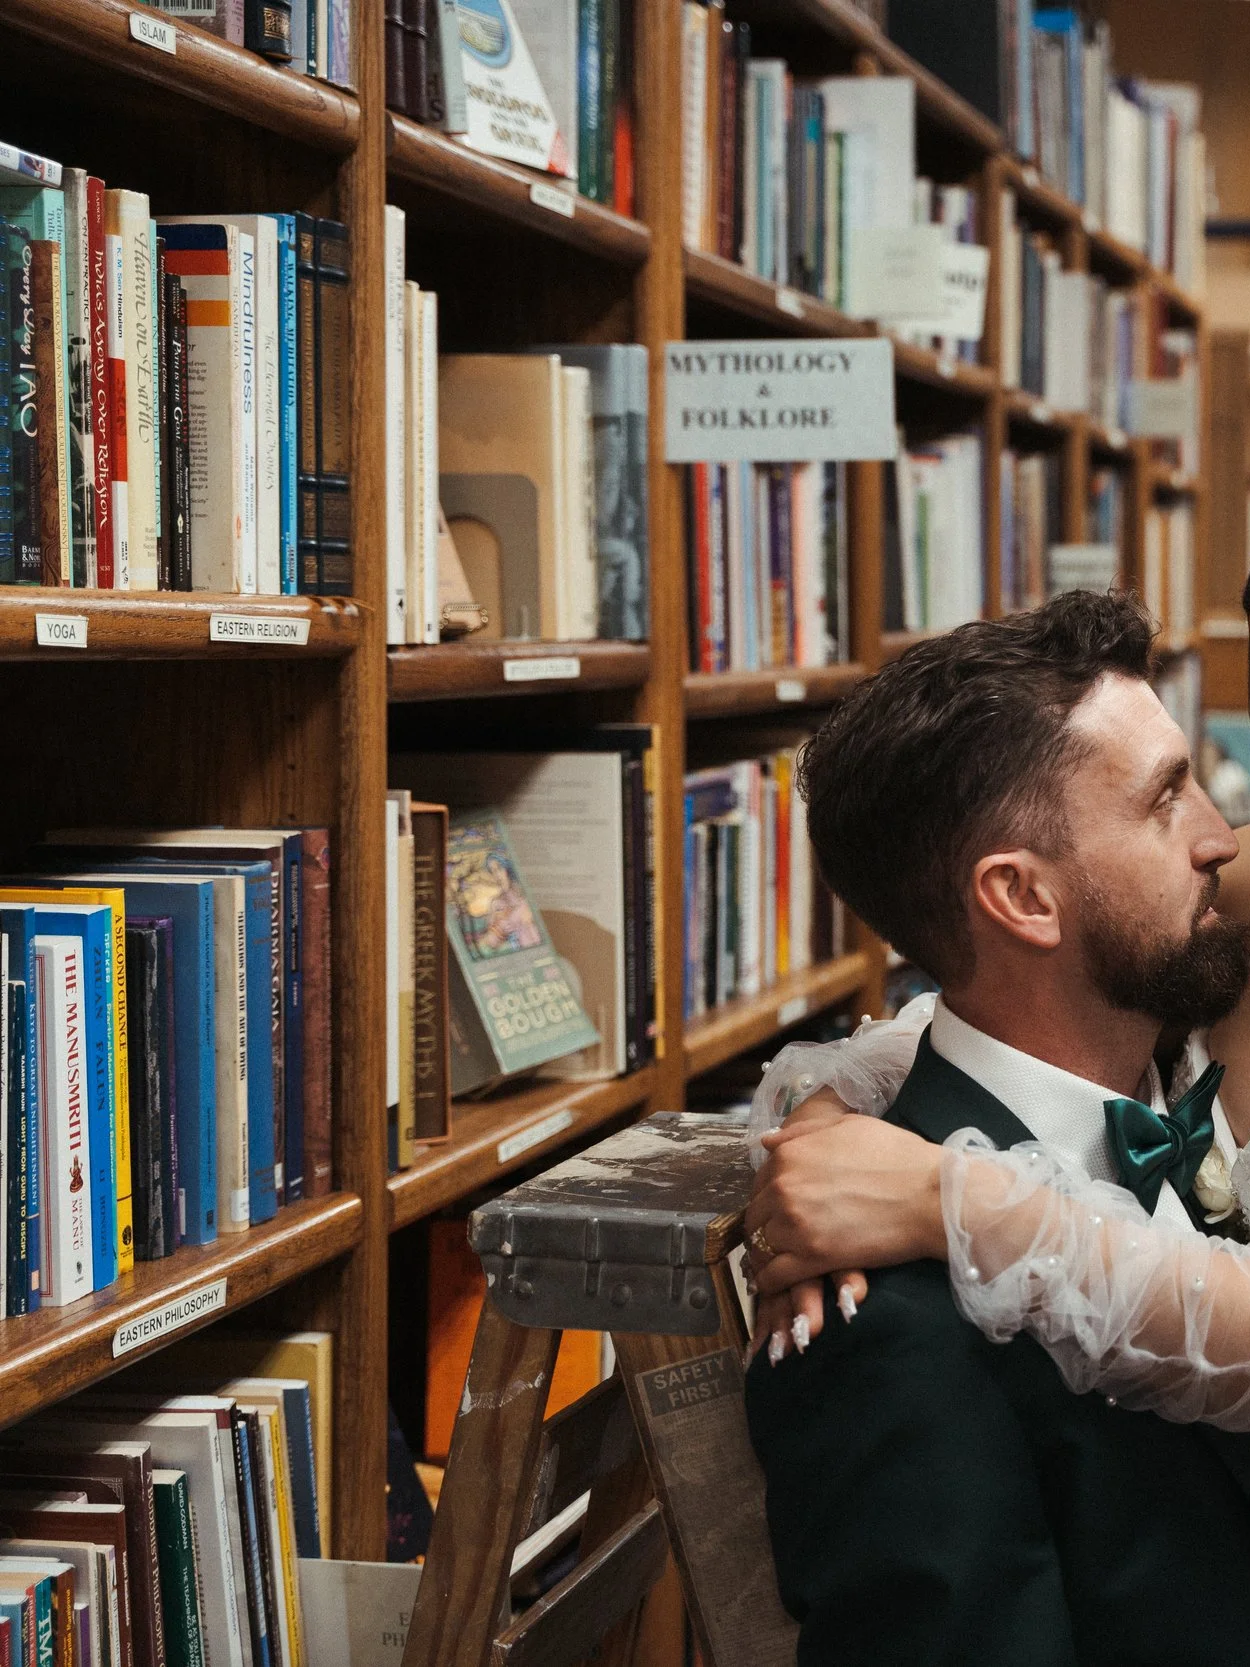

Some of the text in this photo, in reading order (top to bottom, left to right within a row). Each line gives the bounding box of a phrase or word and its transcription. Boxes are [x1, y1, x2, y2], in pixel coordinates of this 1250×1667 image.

[138, 20, 167, 44] ISLAM
[116, 247, 123, 255] K.
[116, 259, 123, 270] M.
[20, 245, 33, 307] Every
[21, 306, 36, 355] Day
[55, 338, 62, 351] OF
[133, 232, 154, 444] Heaven on Earth
[243, 251, 254, 414] Mindfulness
[264, 329, 275, 352] The
[287, 262, 295, 407] WALKING MEDITATION
[161, 355, 167, 366] of
[172, 340, 182, 371] PATH
[669, 350, 856, 375] MYTHOLOGY
[94, 250, 110, 529] India's Agony Over Religion
[175, 371, 180, 383] IS
[757, 381, 771, 397] &
[173, 406, 184, 442] GOAL
[681, 407, 835, 429] FOLKLORE
[58, 425, 66, 478] EVOLUTION
[47, 623, 77, 640] YOGA
[217, 620, 298, 638] EASTERN RELIGION
[237, 911, 246, 969] MEDITATION
[414, 848, 437, 1078] THE GREEK MYTHS
[115, 914, 127, 1052] A SECOND CHANCE
[238, 971, 246, 992] AND
[238, 995, 246, 1012] THE
[486, 980, 572, 1018] GOLDEN
[93, 945, 106, 1111] ZHUAN FALUN
[495, 998, 580, 1039] BOUGH
[30, 1037, 37, 1053] TO
[65, 949, 82, 1151] THE MANUSMRITI
[239, 1036, 247, 1048] OF
[239, 1051, 247, 1081] DYING
[31, 1102, 39, 1207] ENLIGHTENMENT
[99, 1169, 105, 1183] LI
[20, 1204, 27, 1217] TO
[71, 1199, 80, 1251] MANU
[119, 1286, 221, 1347] EASTERN PHILOSOPHY
[654, 1356, 726, 1390] SAFETY
[668, 1378, 722, 1407] FIRST
[180, 1508, 188, 1549] GODMAN
[145, 1471, 165, 1659] A BUDDHIST PHILOSOPHY
[219, 1499, 238, 1636] Boston Confucianism
[38, 1608, 53, 1662] TM
[187, 1630, 193, 1640] OF
[191, 1615, 197, 1624] BE
[191, 1627, 197, 1637] AS
